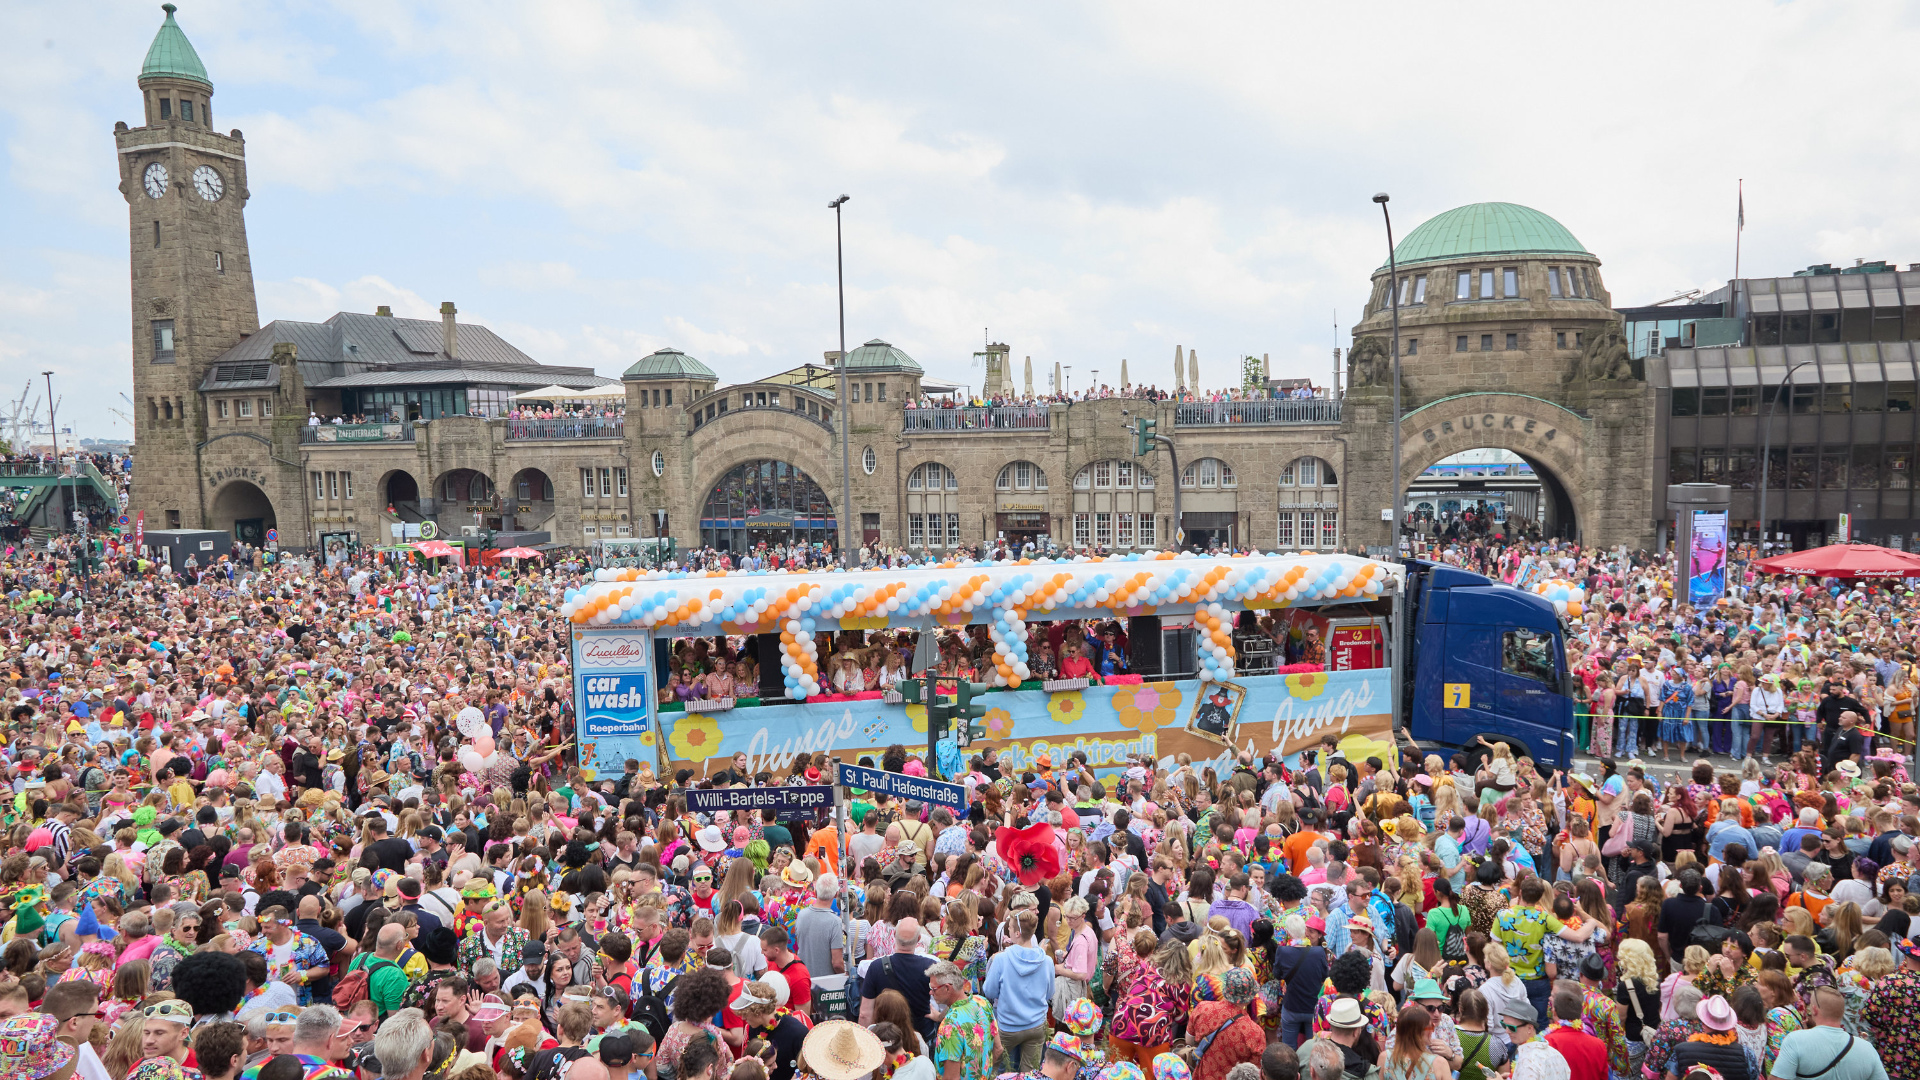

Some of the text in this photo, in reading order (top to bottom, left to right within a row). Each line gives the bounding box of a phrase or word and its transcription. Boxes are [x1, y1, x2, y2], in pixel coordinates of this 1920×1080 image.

[1014, 503, 1044, 512] Hamburg
[586, 645, 640, 657] Lucullus
[587, 677, 621, 693] car
[587, 686, 642, 709] wash
[1452, 692, 1461, 707] 7
[1271, 678, 1375, 754] Jungs
[589, 723, 647, 733] Reeperbahn
[845, 768, 959, 804] St. Pauli Hafenstraße
[695, 790, 825, 807] Willi-Bartels-Tppe
[829, 1002, 847, 1011] HAM
